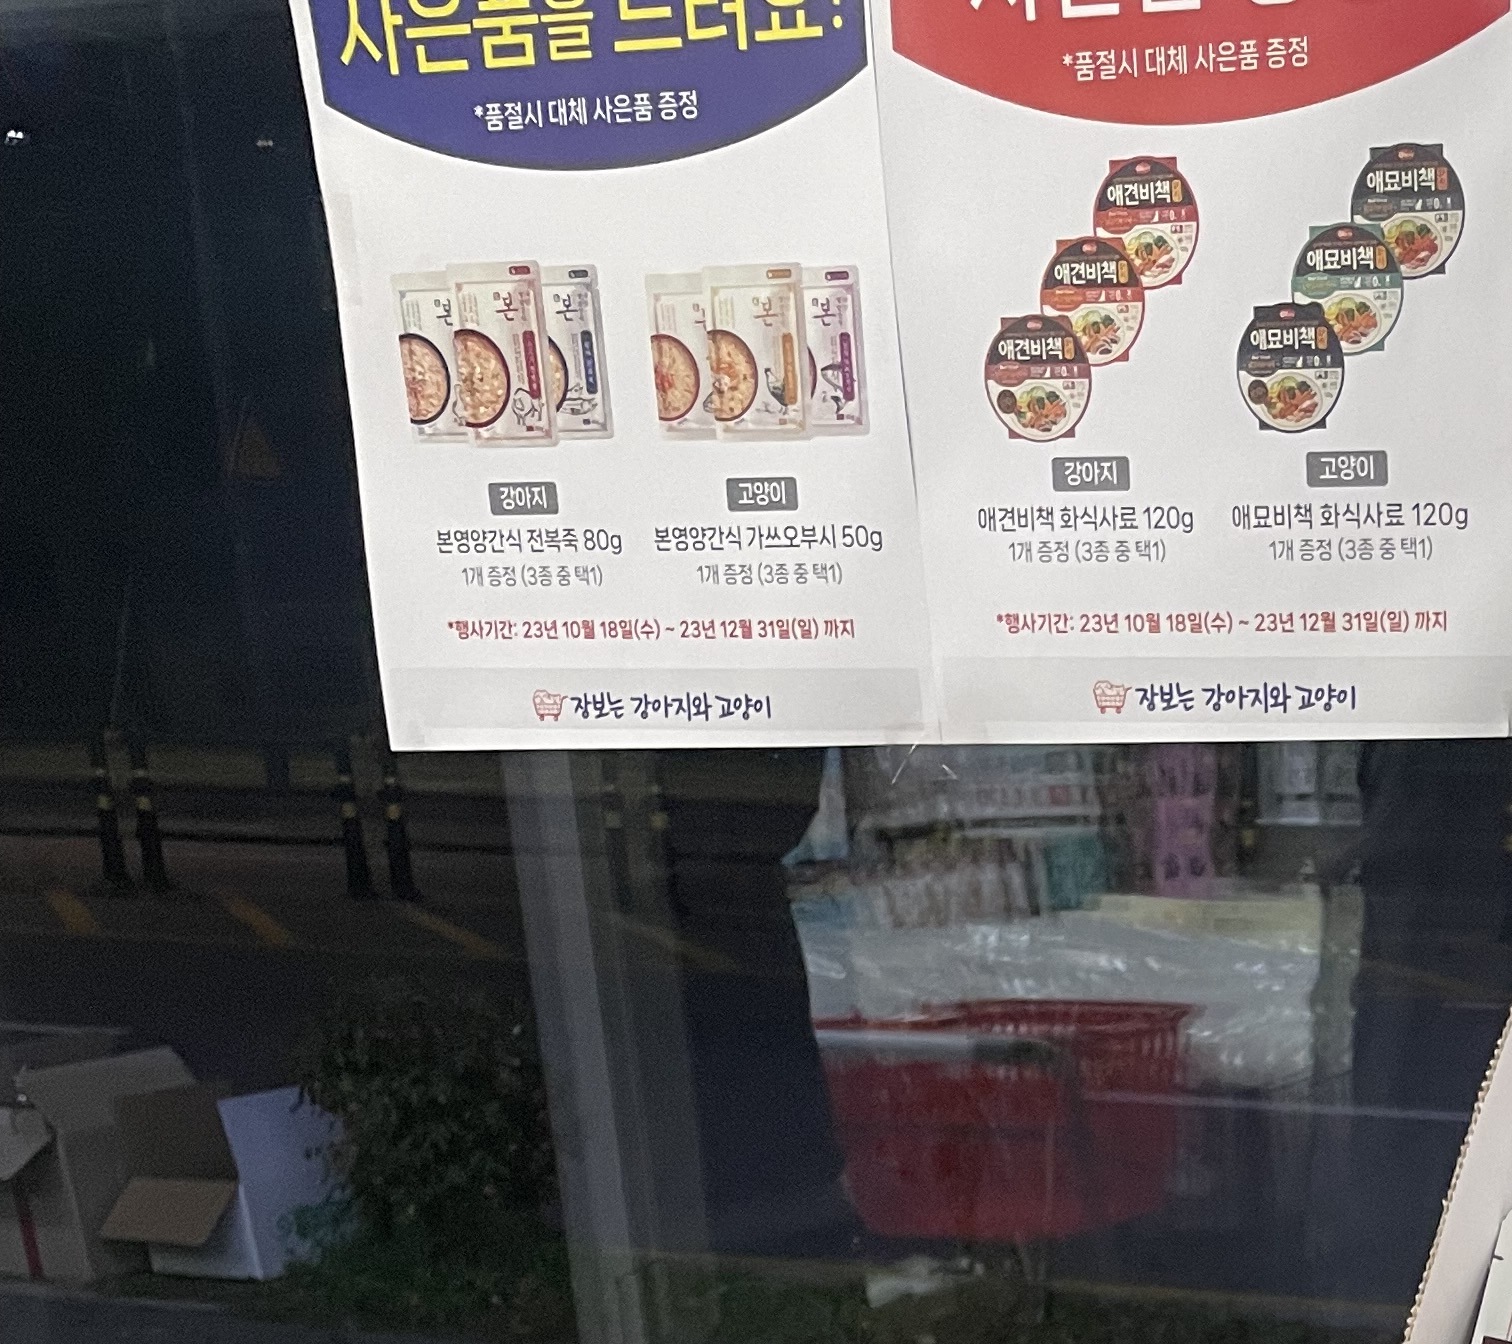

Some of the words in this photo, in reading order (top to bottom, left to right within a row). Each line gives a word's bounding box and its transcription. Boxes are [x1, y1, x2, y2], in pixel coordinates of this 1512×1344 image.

[1145, 41, 1188, 76] 대체
[1195, 39, 1258, 74] 사은품
[1265, 36, 1309, 70] 증정
[549, 95, 587, 126] 대체
[594, 92, 653, 124] 사은품
[657, 89, 698, 121] 증정
[1064, 461, 1119, 486] 강아지
[1318, 455, 1375, 481] 고양이
[500, 485, 548, 510] 강아지
[738, 481, 787, 506] 고양이
[977, 505, 1054, 532] 애견비책
[1059, 505, 1139, 531] 화식사료
[1142, 505, 1194, 535] 120g
[1231, 502, 1313, 531] 애묘비책
[1320, 501, 1404, 530] 화식사료
[1411, 502, 1469, 532] 120g
[436, 528, 521, 554] 본영양간식
[526, 528, 579, 553] 전복죽
[583, 530, 623, 555] 80g
[654, 526, 742, 552] 본영양간식
[746, 524, 837, 551] 가쓰오부시
[842, 526, 884, 552] 50g
[1008, 540, 1034, 564] 1개
[1038, 539, 1070, 564] 증정
[1074, 538, 1110, 565] (3종
[1115, 539, 1131, 562] 중
[1135, 538, 1167, 564] 택1)
[1079, 611, 1121, 635] 23년
[1124, 611, 1162, 635] 10월
[1166, 611, 1233, 635] 18일(수)
[1254, 611, 1295, 634] 23년
[1299, 611, 1337, 634] 12월
[1341, 610, 1410, 635] 31일(일)
[1414, 609, 1448, 634] 까지
[1135, 684, 1196, 711] 장보는
[1201, 683, 1291, 713] 강아지와
[1297, 683, 1358, 713] 고양이
